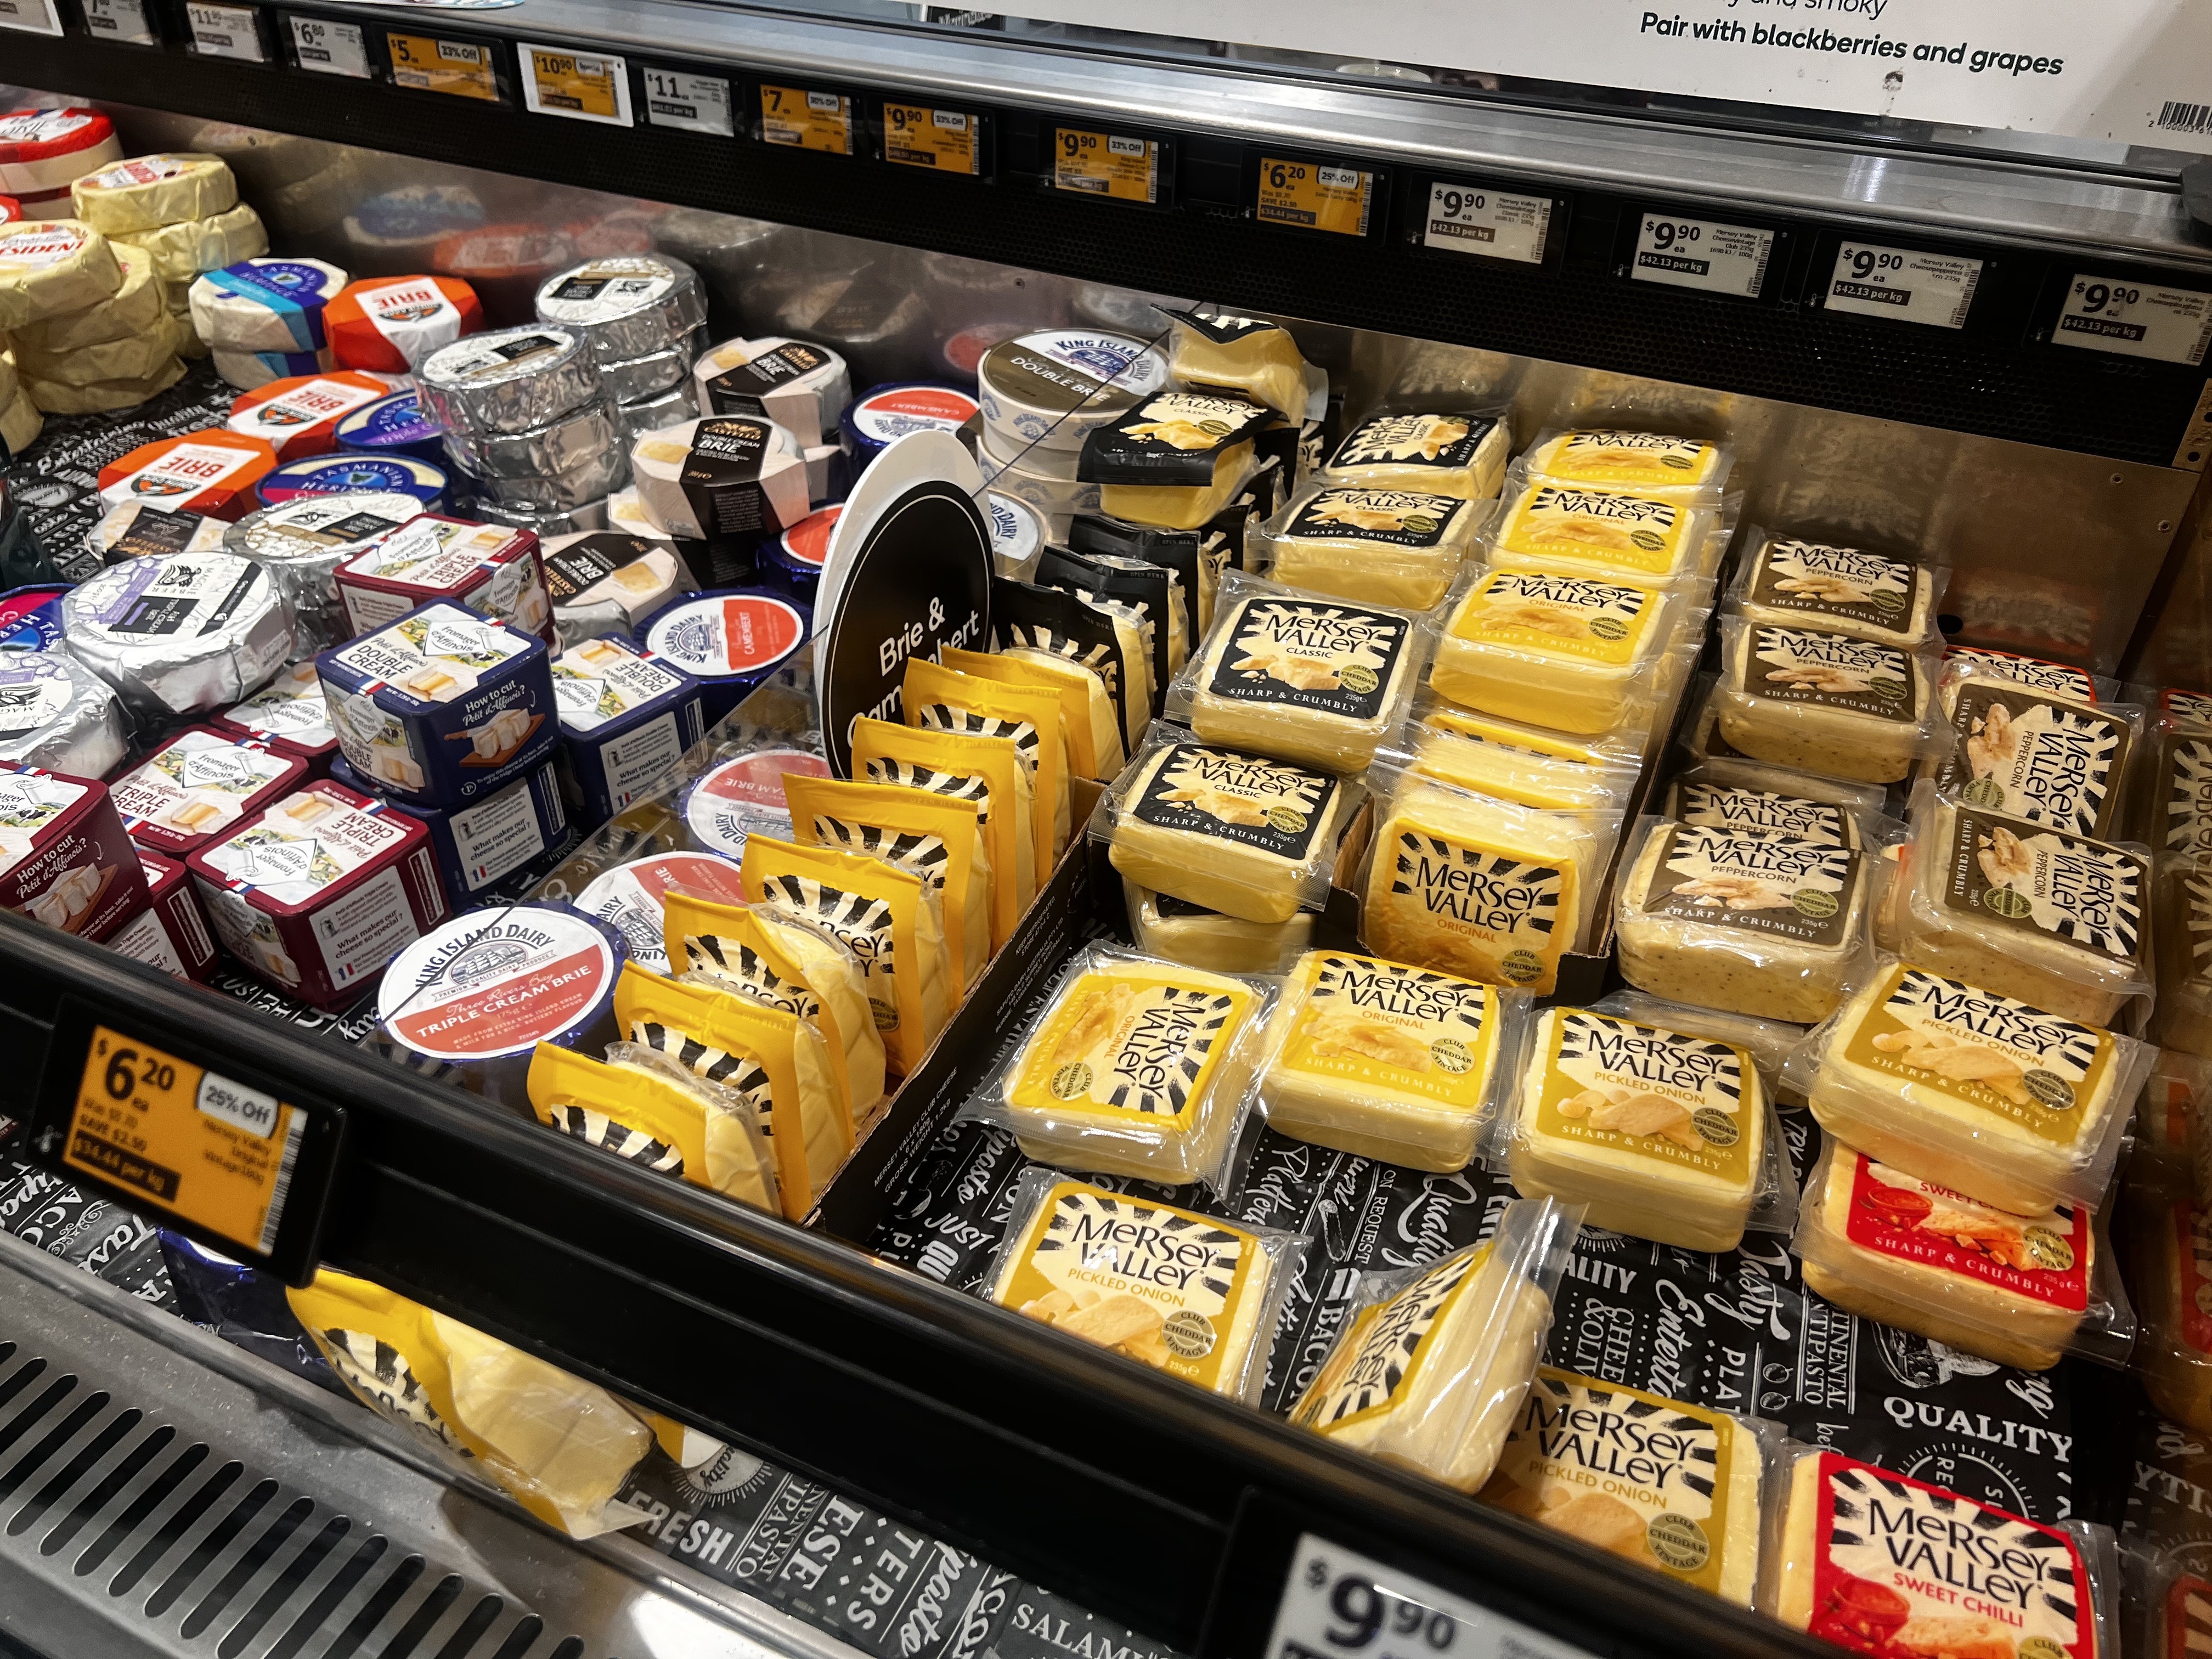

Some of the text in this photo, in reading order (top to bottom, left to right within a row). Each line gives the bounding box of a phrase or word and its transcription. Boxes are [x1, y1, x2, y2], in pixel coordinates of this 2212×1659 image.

[1640, 12, 2064, 76] Pair with blackberries and grapes
[1340, 174, 1355, 183] Off
[1432, 223, 1489, 240] $42.13 per kg
[1640, 255, 1702, 272] $42.13 per kg
[1920, 258, 1965, 270] Mersey Valley
[1836, 284, 1903, 303] $42.13 per kg
[2064, 319, 2137, 337] $42.13 per kg
[1056, 338, 1152, 381] KING ISLAND DAIRY
[1009, 356, 1113, 404] DOUBLE BRIE
[285, 391, 346, 411] BRIE
[697, 439, 738, 454] BRIE
[162, 456, 224, 478] BRIE
[1528, 599, 1587, 612] ORIGINAL
[673, 614, 704, 631] DAIRY
[740, 612, 755, 655] CAMEMBERT
[879, 597, 946, 677] Brie &
[347, 653, 400, 680] CREAM
[357, 644, 413, 675] DOUBLE
[676, 648, 706, 664] KING
[1286, 647, 1333, 658] CLASSIC
[1797, 658, 1870, 674] PEPPERCORN
[1341, 670, 1377, 686] CHEDDAR
[1352, 664, 1372, 674] CLUB
[465, 680, 516, 713] How to cut
[1342, 677, 1372, 693] VINTAGE
[1229, 687, 1273, 697] SHARP
[1293, 693, 1358, 713] CRUMBLY
[462, 709, 483, 726] Petit
[117, 786, 170, 808] TRIPLE
[16, 834, 75, 883] How to cut
[16, 876, 41, 899] Petit
[1711, 866, 1797, 885] PEPPERCORN
[2034, 849, 2048, 899] PEPPERCORN
[336, 917, 399, 958] cheese so special
[337, 910, 398, 949] What makes our
[1436, 918, 1497, 943] ORIGINAL
[415, 956, 446, 988] KING
[443, 927, 503, 957] ISLAND
[505, 924, 556, 947] DAIRY
[1503, 961, 1543, 973] CHEDDAR
[416, 966, 592, 1037] TRIPLE CREAM BRIE
[1362, 1011, 1426, 1030] ORIGINAL
[1104, 1015, 1136, 1058] ORIGINAL
[1922, 1018, 2046, 1067] PICKLED ONION
[1431, 1046, 1472, 1065] CHEDDAR
[1305, 1057, 1454, 1097] SHARP & CRUMBLY
[1594, 1072, 1706, 1105] PICKLED ONION
[205, 1085, 241, 1112] 25%
[241, 1100, 272, 1126] Off
[874, 1066, 957, 1187] MERSEY VALLEY CLUB CHEESE
[884, 1098, 951, 1193] GROSS WEIGHT 1.2kg
[924, 1212, 995, 1250] JUST
[1355, 1195, 1389, 1265] REQUEST
[1874, 1237, 2055, 1297] SHARP & CRUMBLY
[1067, 1267, 1186, 1307] PICKLED ONION
[1883, 1396, 2072, 1455] QUALITY
[1529, 1461, 1667, 1509] PICKLED ONION
[1893, 1572, 2024, 1628] SWEET CHILLI
